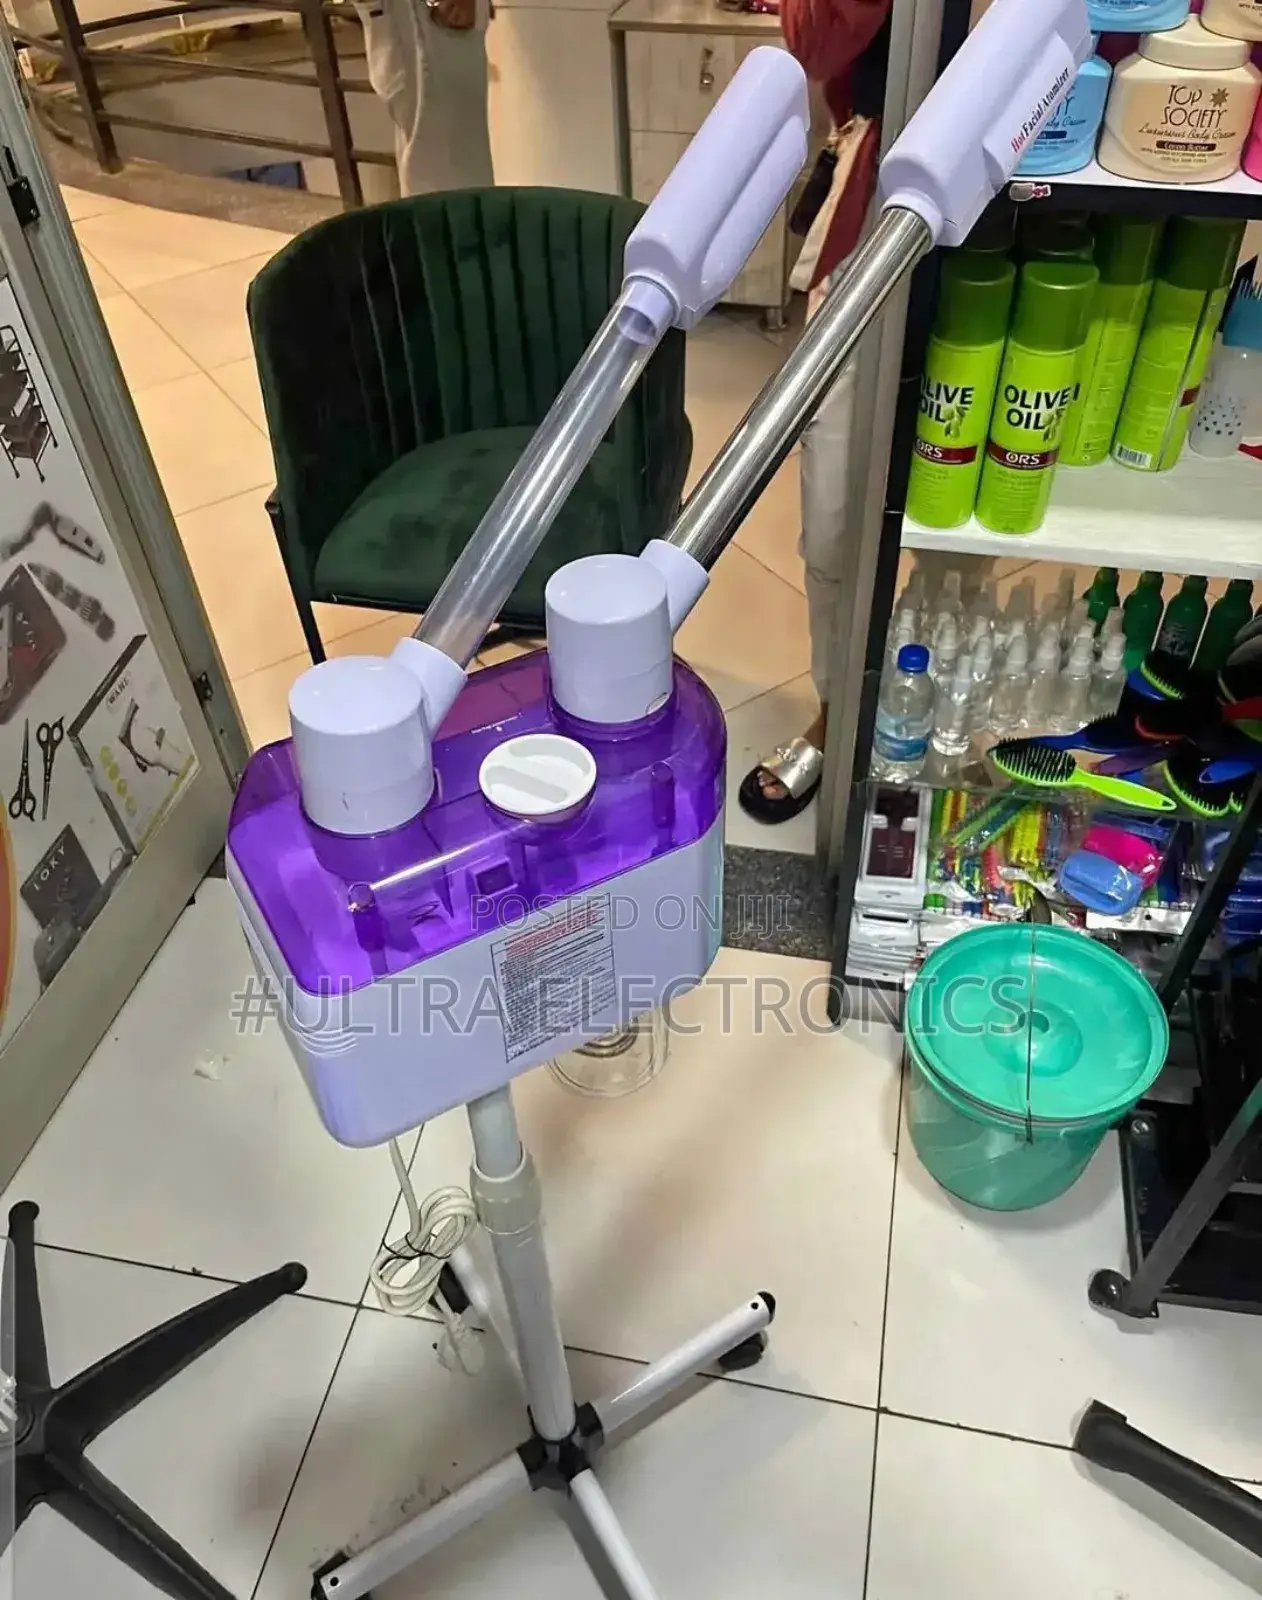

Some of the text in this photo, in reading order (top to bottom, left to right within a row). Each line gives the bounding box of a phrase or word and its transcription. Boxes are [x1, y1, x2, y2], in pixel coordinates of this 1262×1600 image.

[1168, 84, 1203, 106] TOP
[1011, 131, 1026, 153] Hot
[1022, 103, 1044, 137] Facial
[1042, 67, 1070, 111] Atomizer
[1161, 106, 1229, 128] SOCIETY
[1004, 384, 1071, 410] OLIVE
[1006, 408, 1047, 430] OIL
[1005, 451, 1041, 466] ORS
